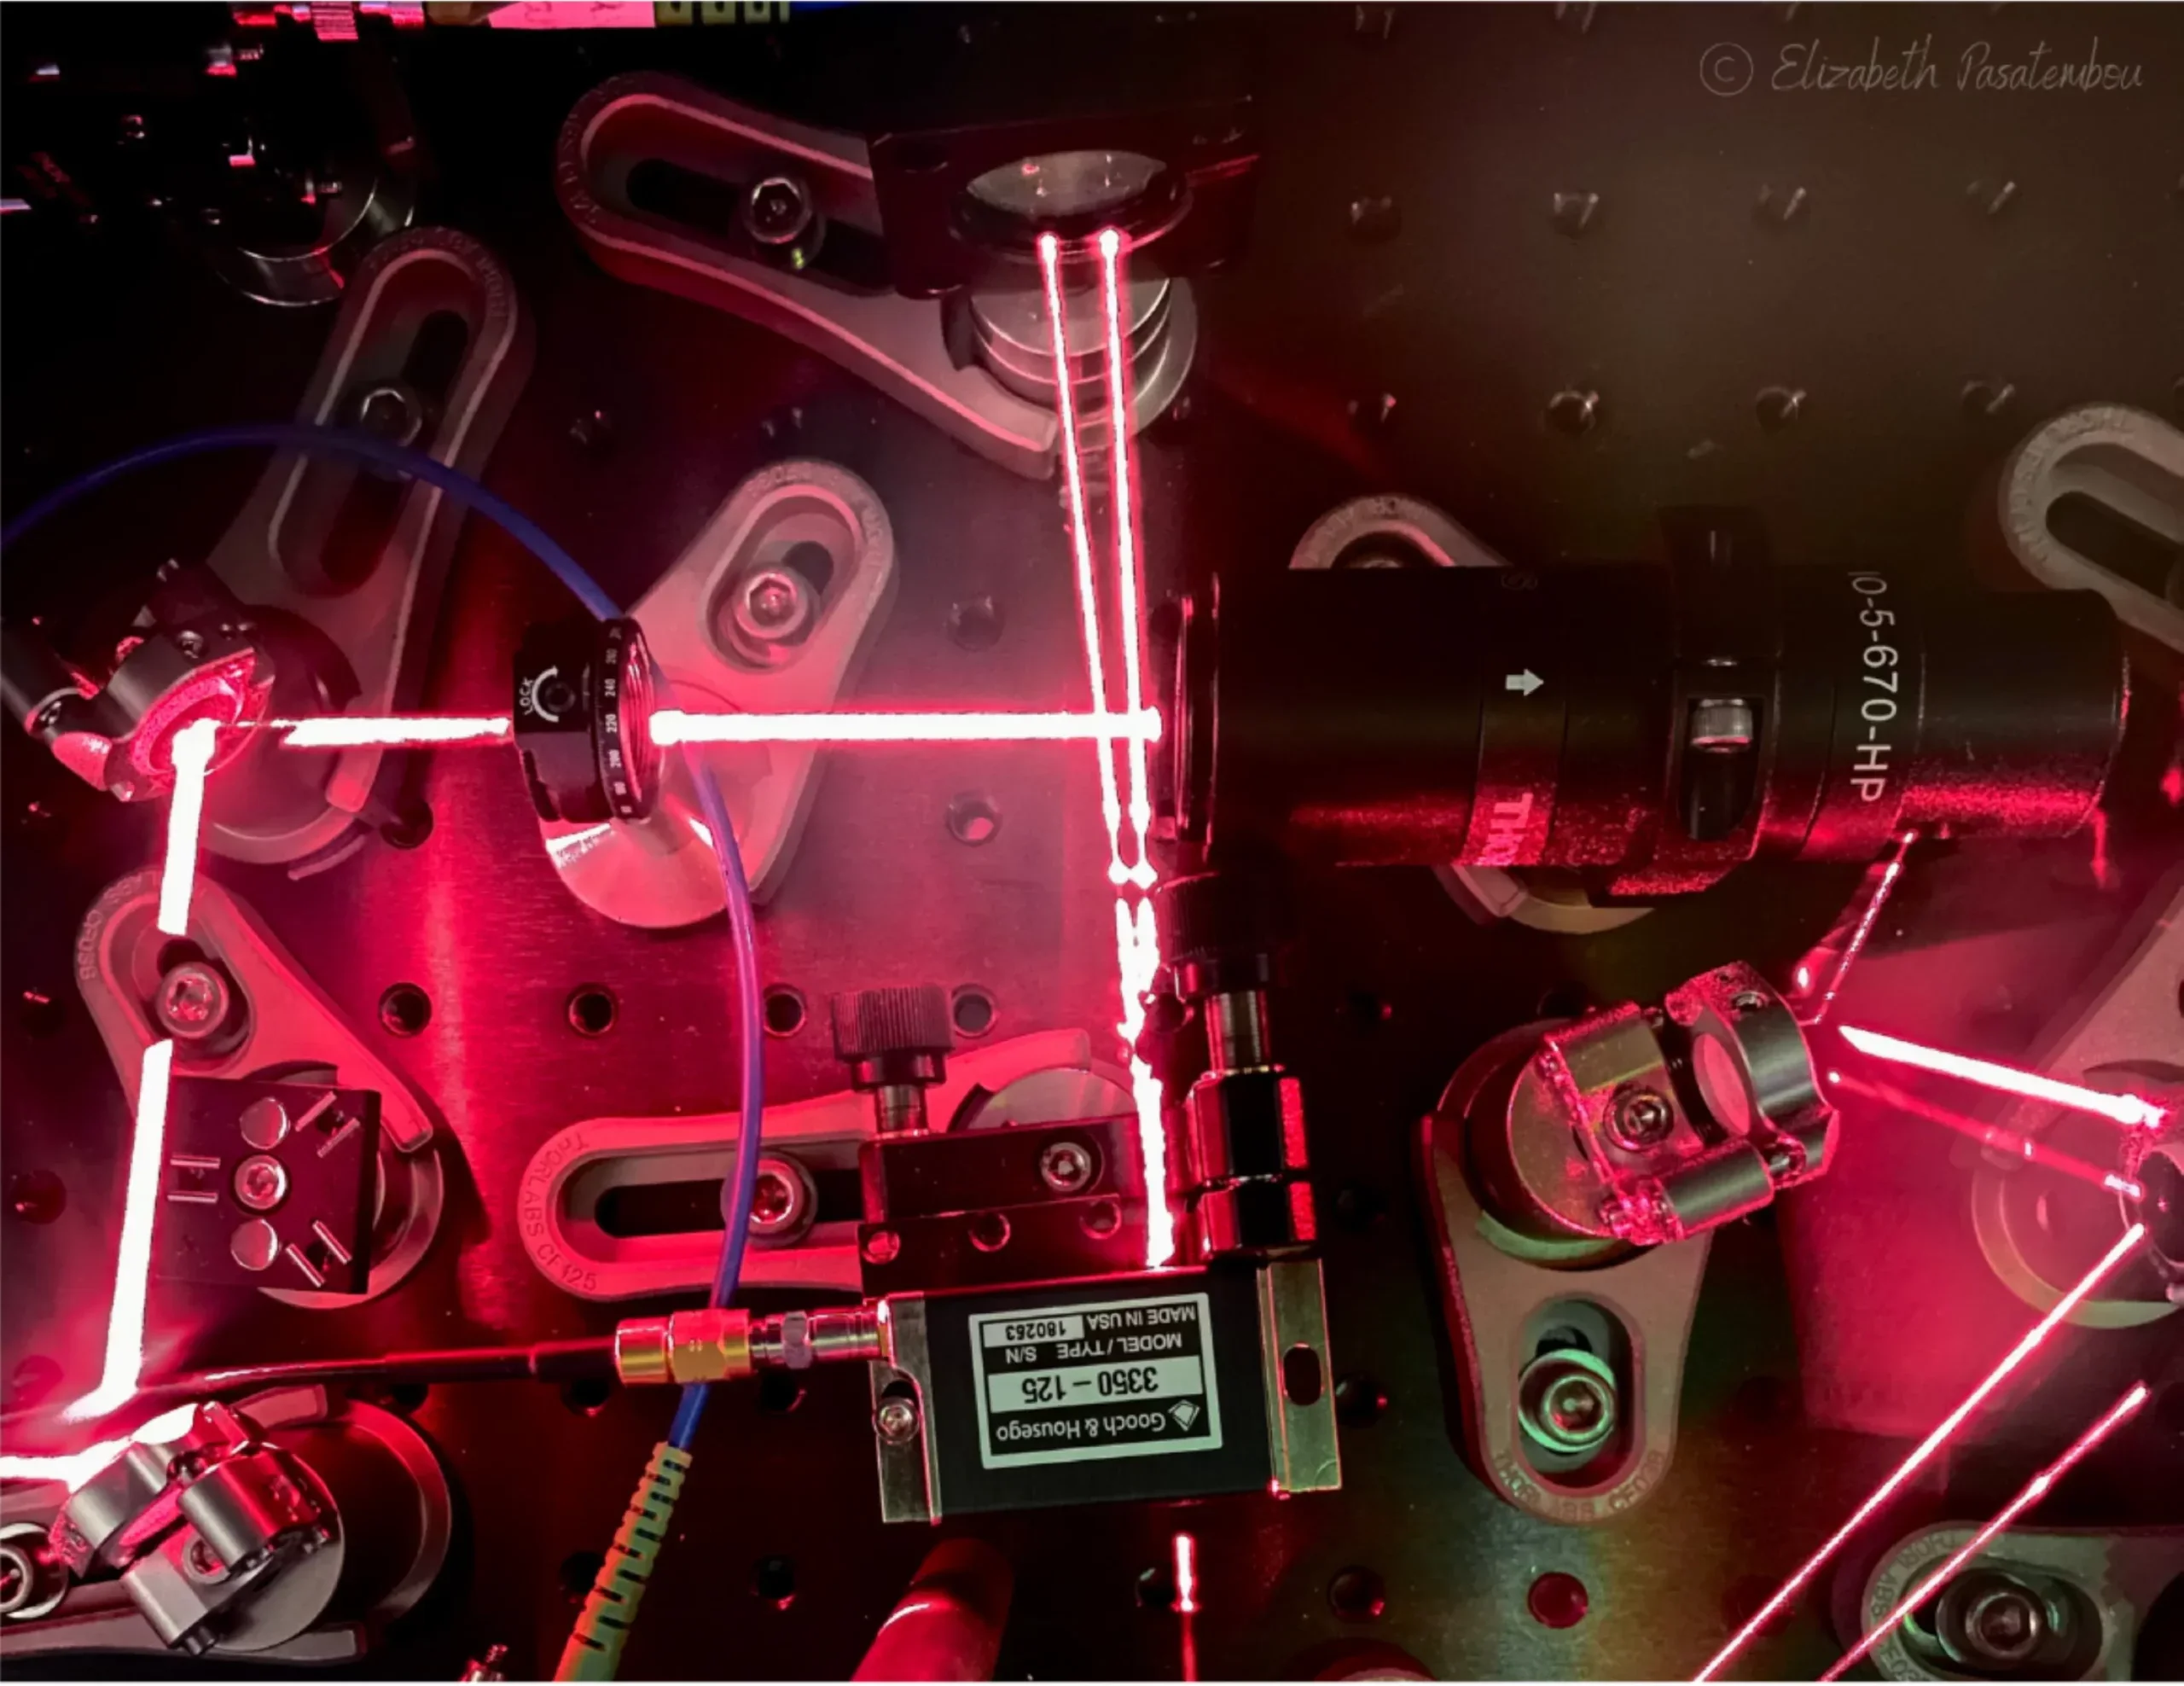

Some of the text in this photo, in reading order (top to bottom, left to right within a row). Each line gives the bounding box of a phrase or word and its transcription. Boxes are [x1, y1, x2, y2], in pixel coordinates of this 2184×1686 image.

[519, 677, 534, 716] LOCK
[604, 678, 617, 697] 240
[605, 713, 618, 733] 220
[523, 1132, 598, 1292] THORLABS CF125
[1086, 1305, 1196, 1330] MADE IN USA
[1005, 1346, 1037, 1364] S/N
[1057, 1342, 1105, 1359] TYPE
[1117, 1333, 1182, 1352] MODEL
[1022, 1375, 1066, 1404] 125
[1098, 1366, 1159, 1397] 3350
[996, 1412, 1166, 1441] Gooch & Housego
